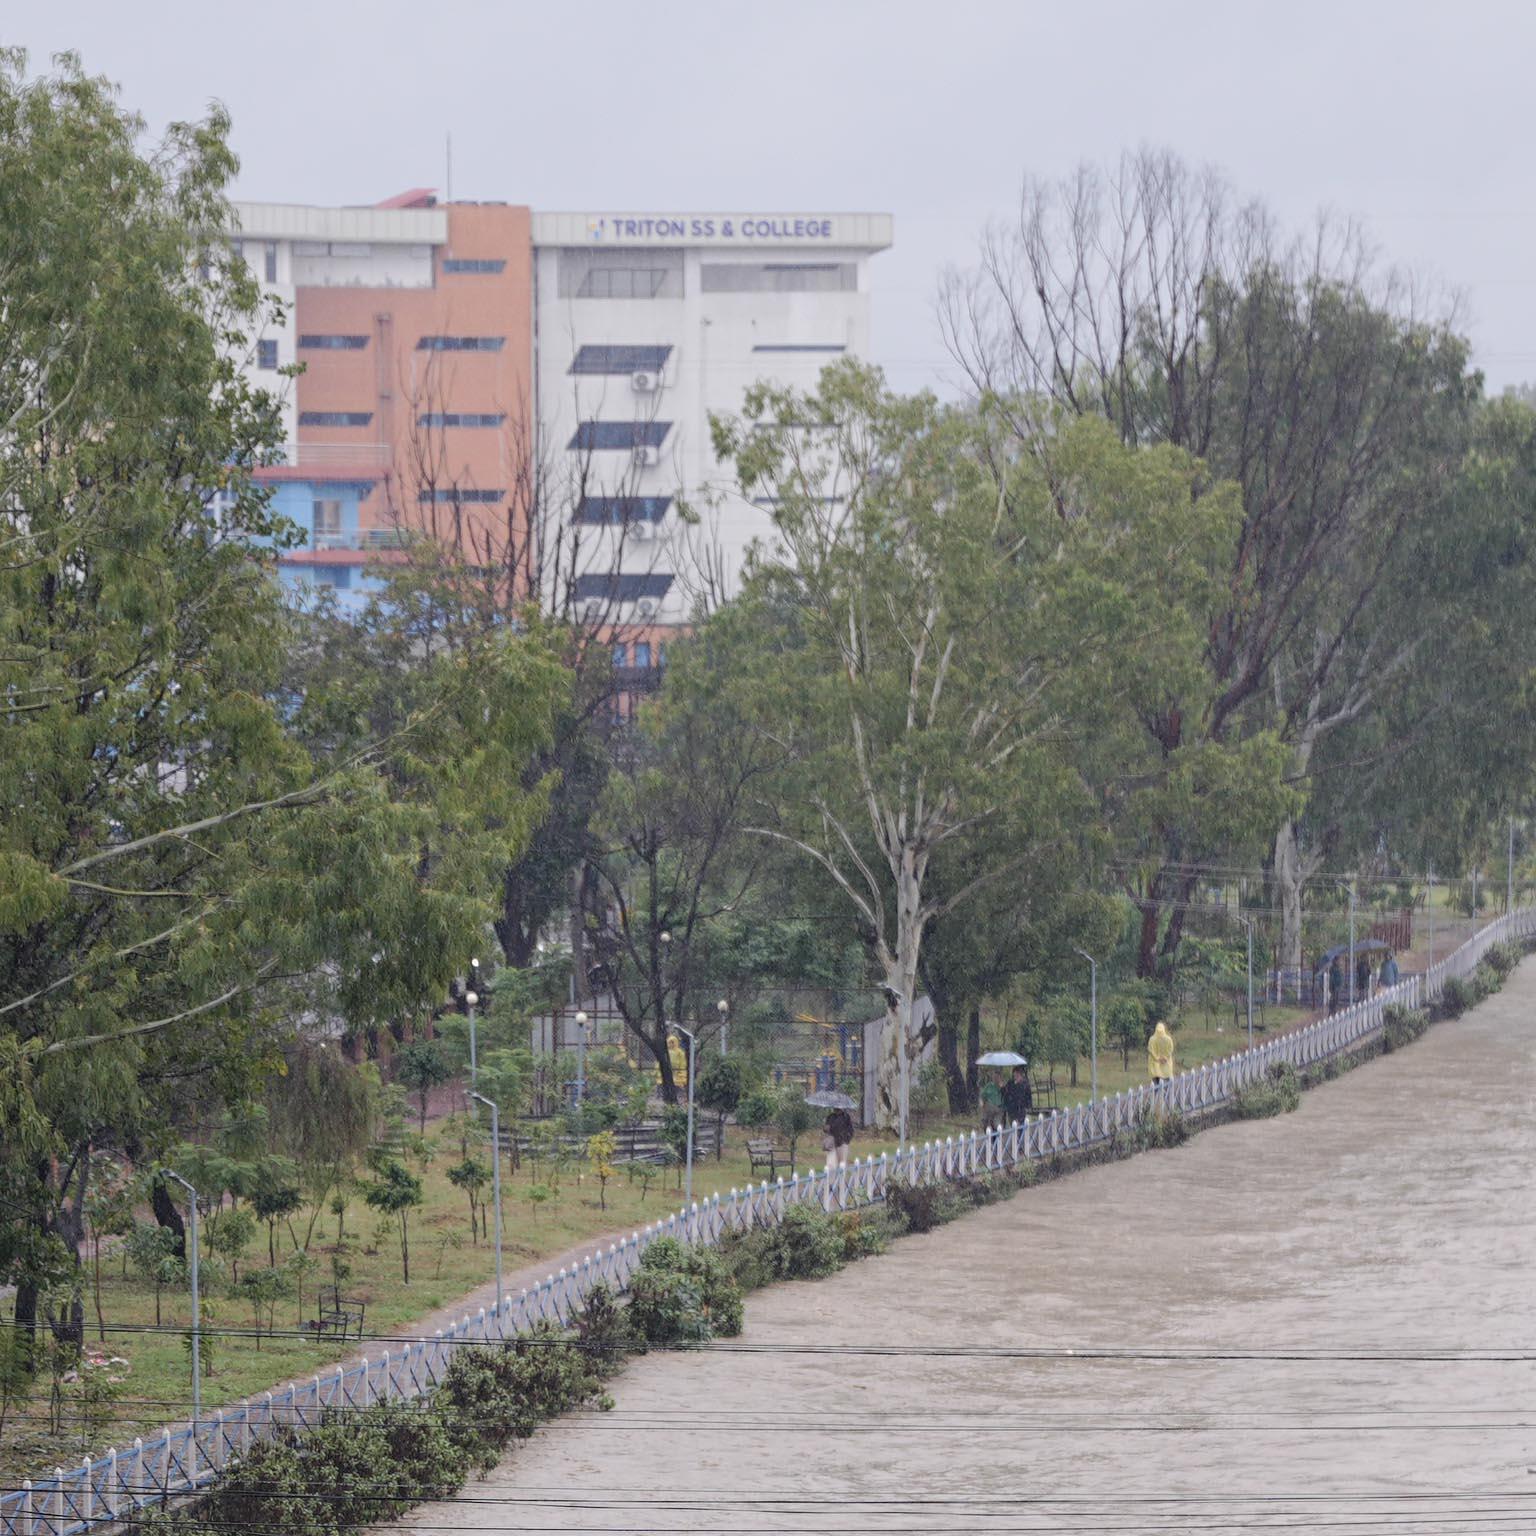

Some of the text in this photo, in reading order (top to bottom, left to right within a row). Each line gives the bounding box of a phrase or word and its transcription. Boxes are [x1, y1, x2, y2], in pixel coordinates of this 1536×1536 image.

[612, 219, 833, 238] TRITON SS & COLLEGE
